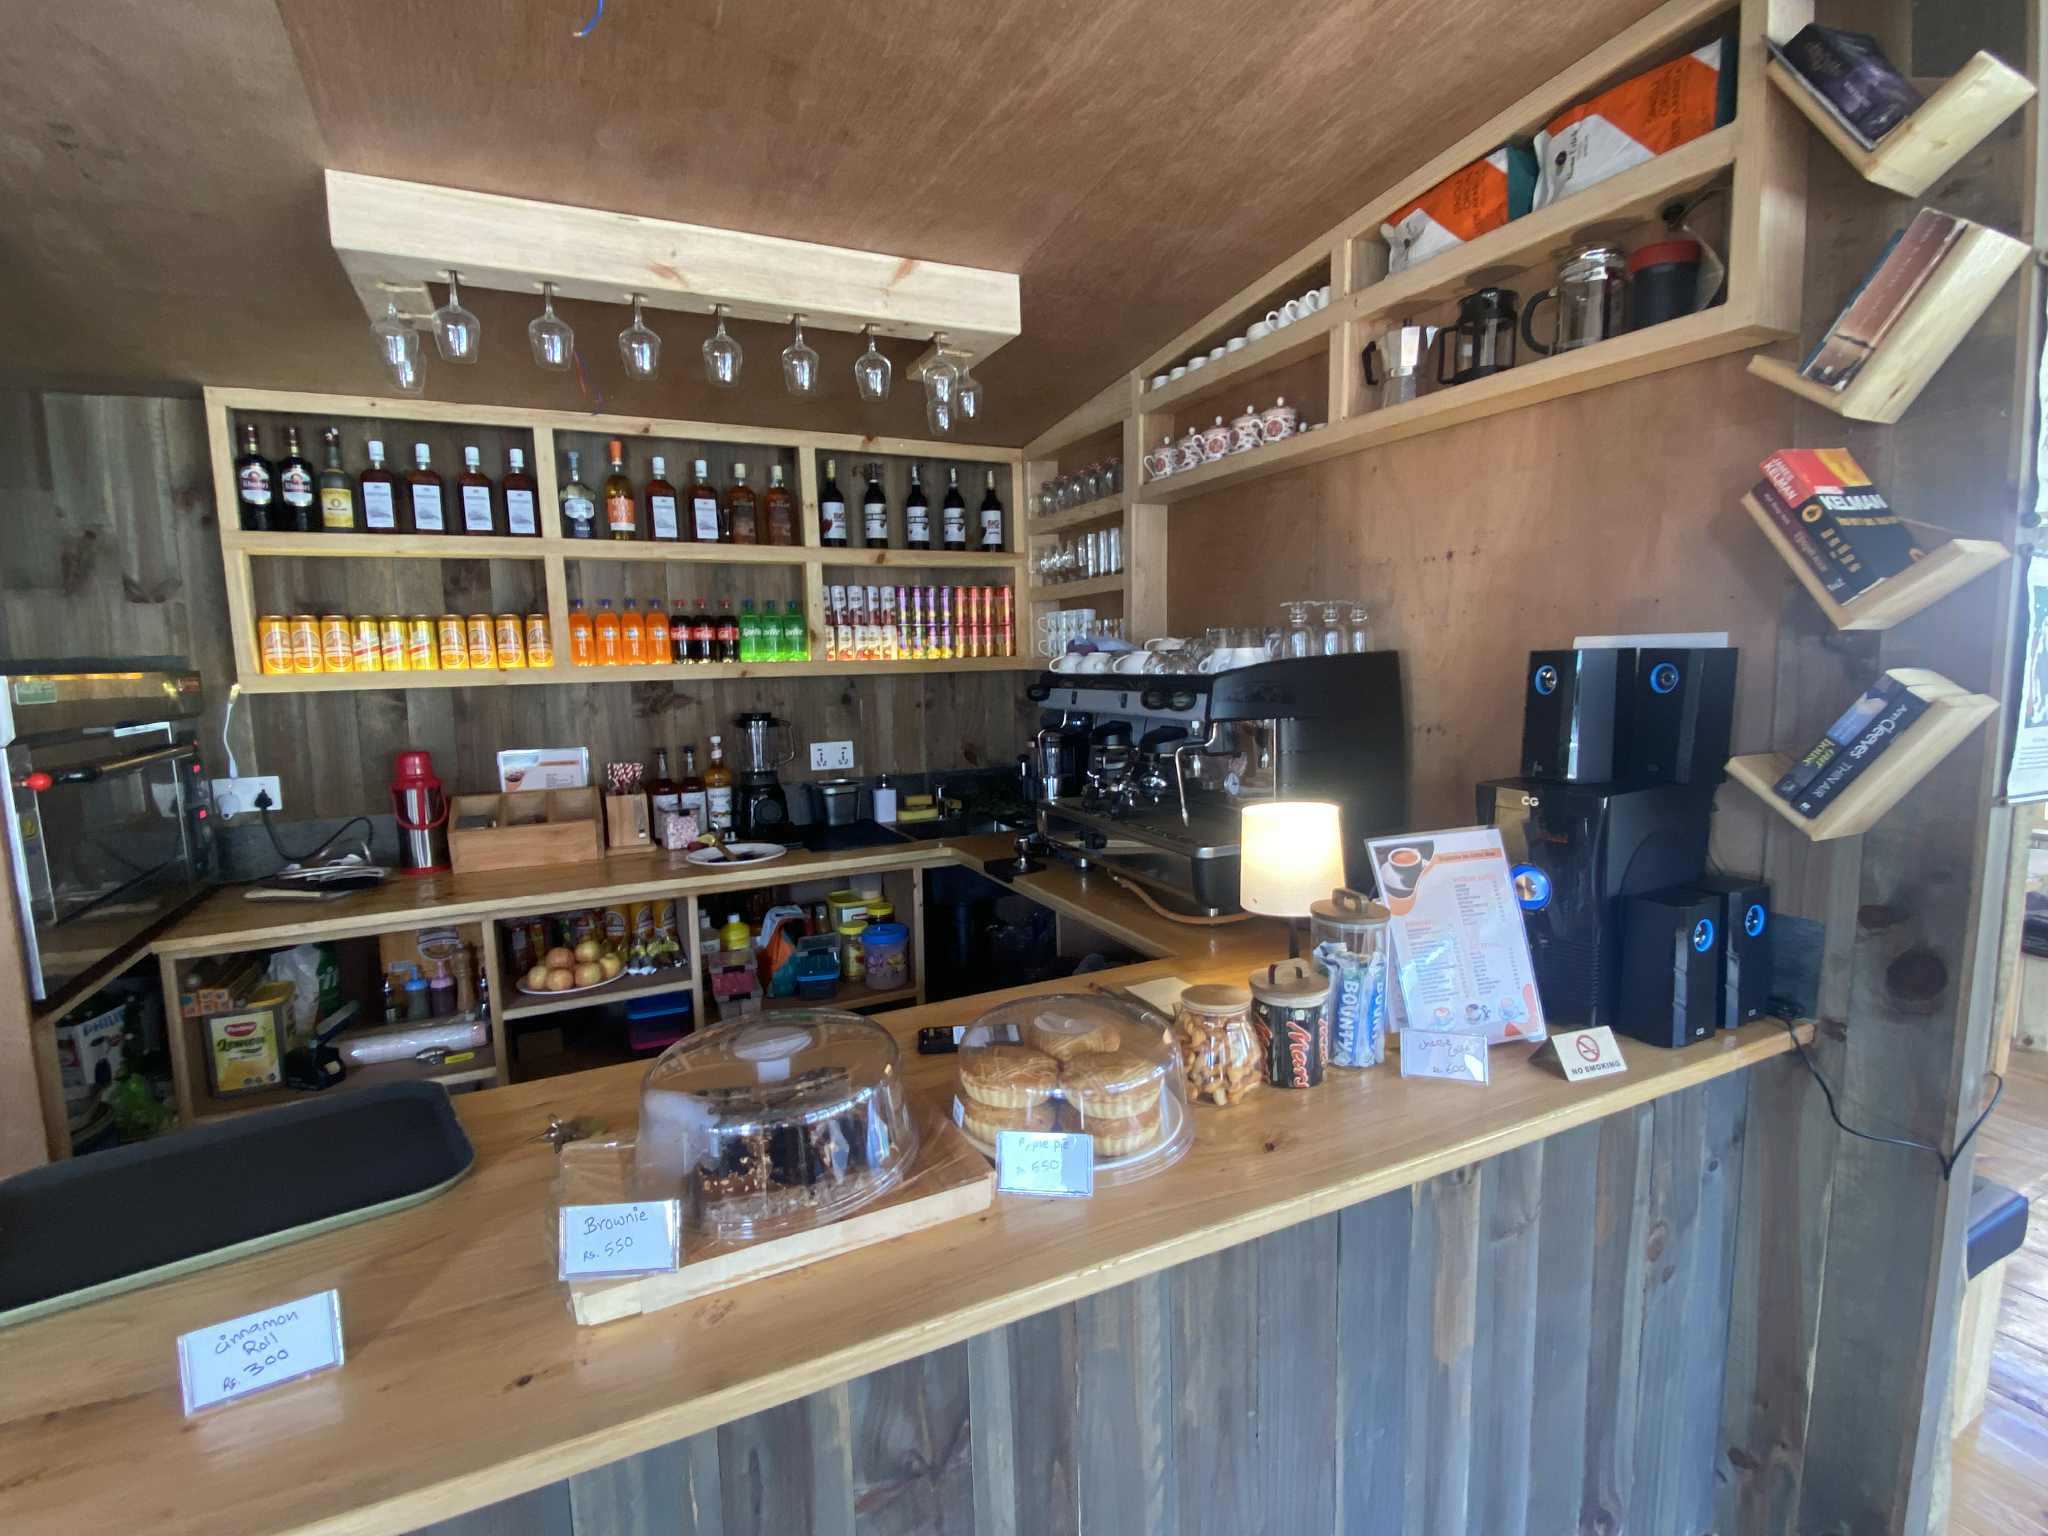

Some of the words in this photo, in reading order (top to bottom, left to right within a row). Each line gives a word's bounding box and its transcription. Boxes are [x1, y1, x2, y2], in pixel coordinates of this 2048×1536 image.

[1763, 461, 1799, 501] KELMAN
[1819, 494, 1889, 511] KELMAN
[1849, 717, 1896, 760] Cleeves
[1825, 761, 1854, 785] THIN
[1521, 796, 1539, 807] CG
[1811, 782, 1832, 798] AIR
[1339, 979, 1360, 1053] BOUNTY
[1285, 1020, 1312, 1089] Mars
[1571, 1066, 1584, 1076] NO
[1584, 1060, 1622, 1074] SMOKING
[583, 1206, 649, 1236] Brownie
[604, 1236, 634, 1257] 550
[241, 1331, 279, 1355] Roll
[242, 1349, 290, 1377] 300
